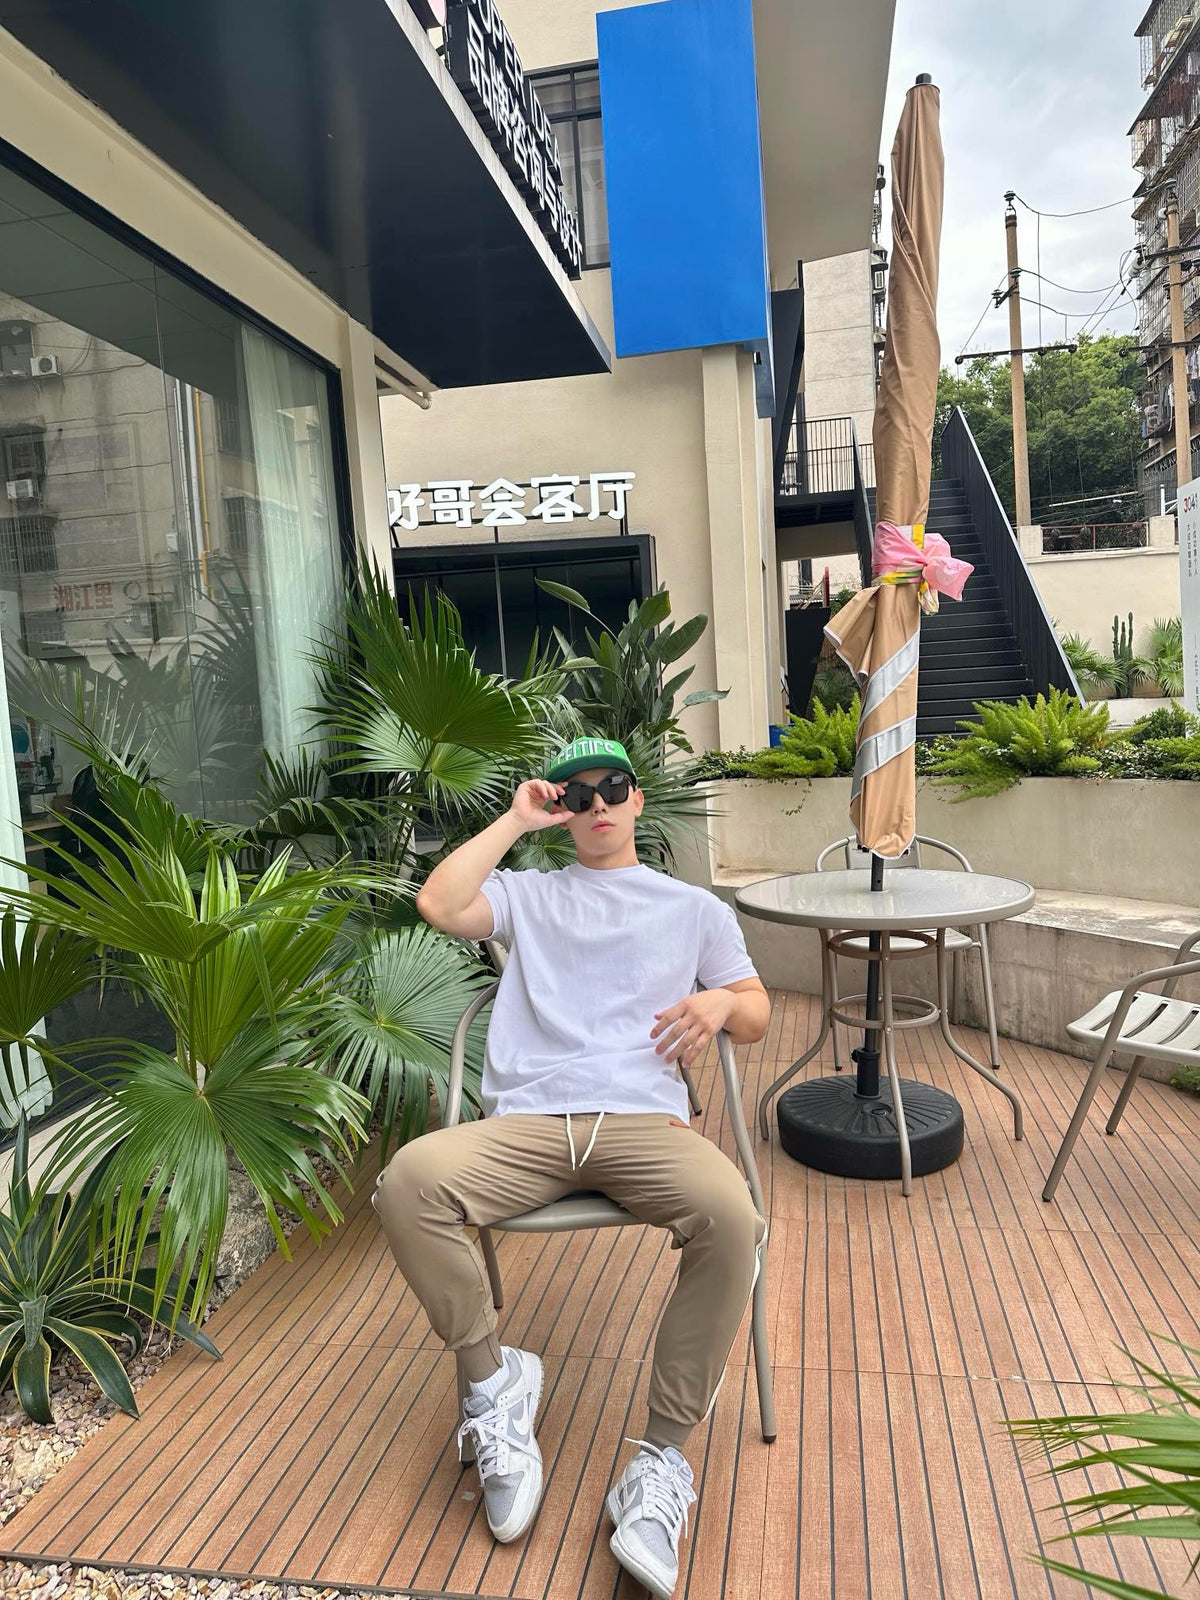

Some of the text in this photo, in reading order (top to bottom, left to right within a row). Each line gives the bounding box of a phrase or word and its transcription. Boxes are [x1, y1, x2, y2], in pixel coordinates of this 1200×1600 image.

[462, 0, 563, 186] UPER IDEA
[467, 6, 583, 267] 品牌咨询与设计
[387, 471, 636, 530] 好哥会客厅
